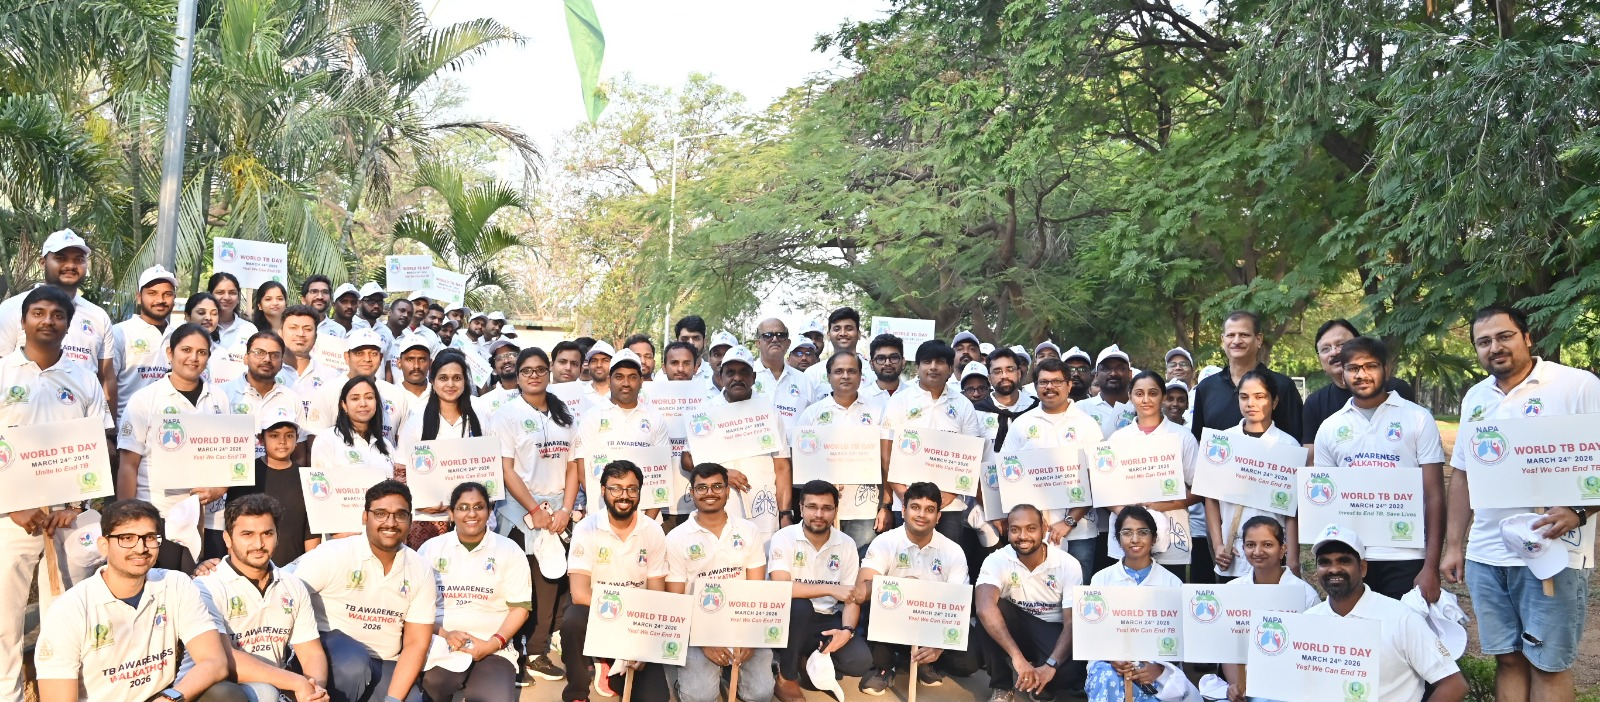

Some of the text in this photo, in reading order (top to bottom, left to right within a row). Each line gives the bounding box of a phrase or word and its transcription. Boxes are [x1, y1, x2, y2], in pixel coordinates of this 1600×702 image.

[718, 419, 742, 429] WORLD
[20, 448, 58, 460] WORLD
[78, 443, 97, 452] DAY
[924, 448, 949, 456] WORLD
[1514, 442, 1600, 455] WORLD TB DAY
[32, 457, 58, 467] MARCH
[1235, 456, 1264, 468] WORLD
[1280, 466, 1297, 474] DAY
[447, 586, 494, 594] AWARENESS
[907, 600, 934, 608] WORLD
[358, 607, 403, 617] AWARENESS
[627, 611, 655, 620] WORLD
[1293, 641, 1371, 658] WORLD TB DAY
[102, 648, 173, 676] TB AWARENESS
[110, 659, 167, 683] WALKATHON
[130, 675, 151, 688] 2026
